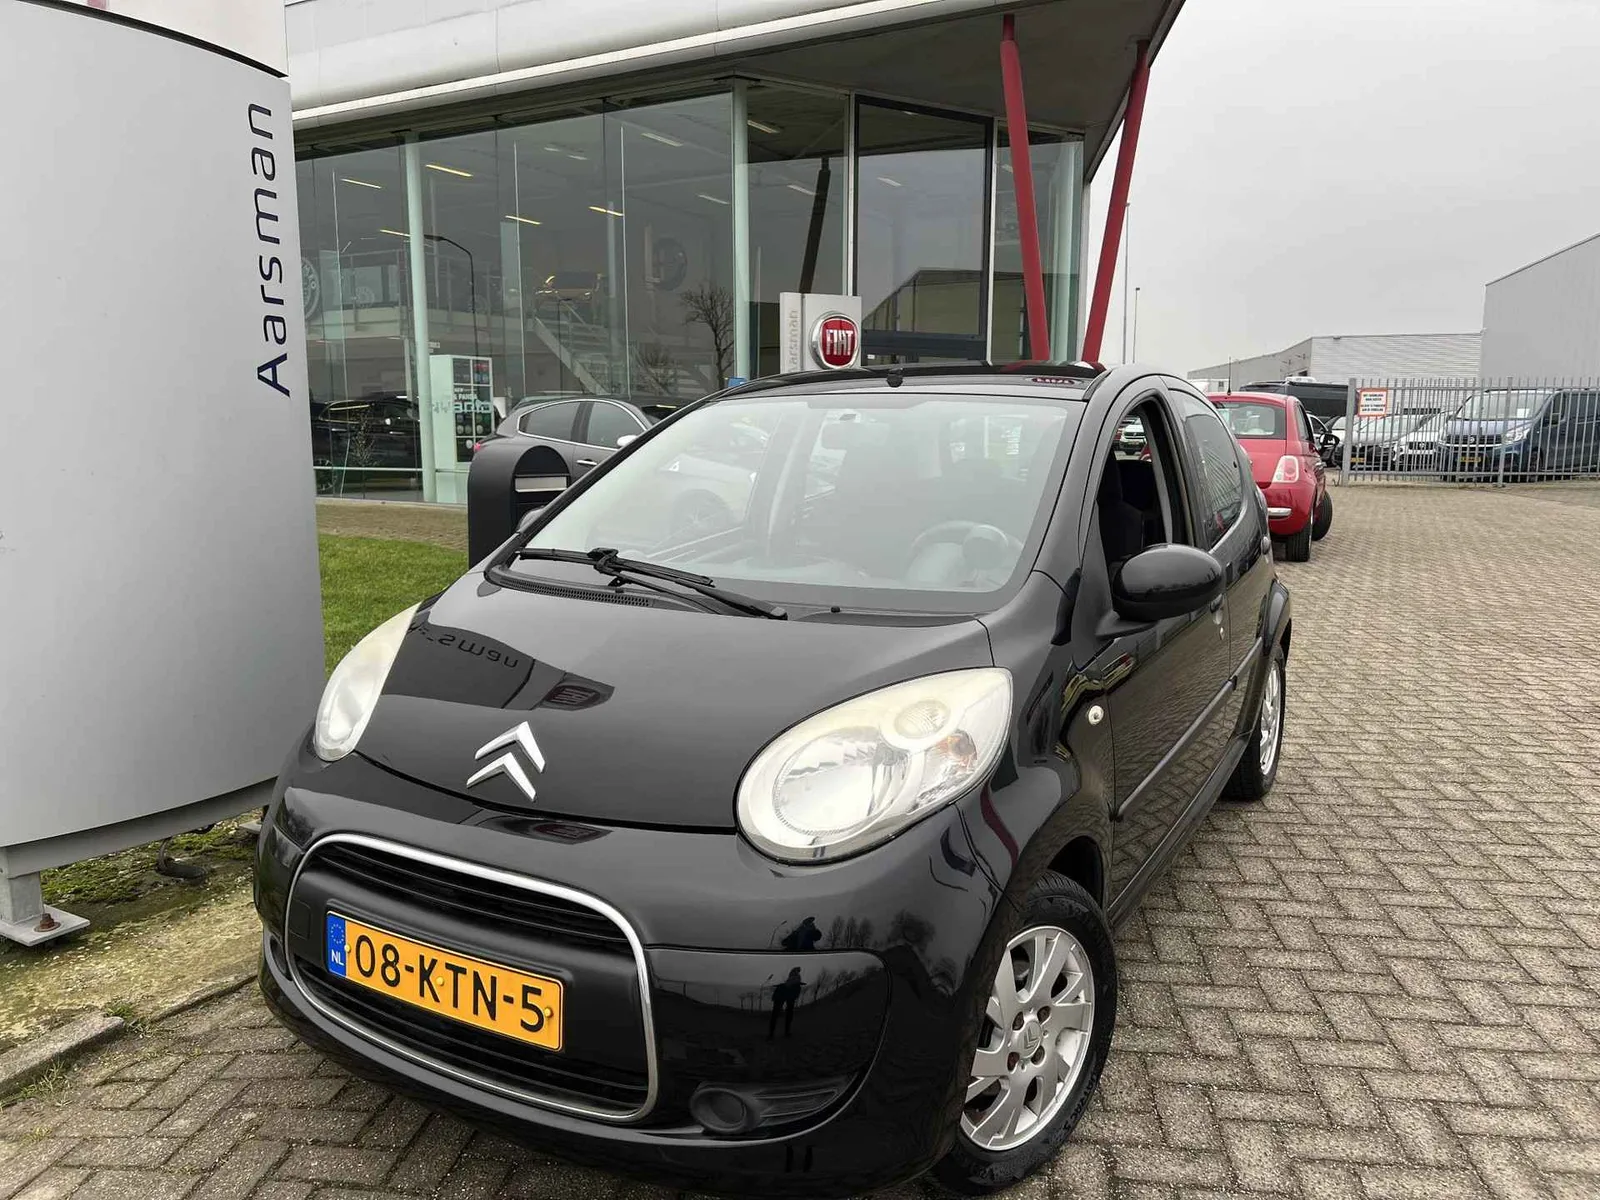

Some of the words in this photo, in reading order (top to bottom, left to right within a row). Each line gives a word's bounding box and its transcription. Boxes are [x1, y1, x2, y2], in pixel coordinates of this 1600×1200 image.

[248, 103, 290, 397] Aarsman
[826, 329, 854, 356] FIAT
[331, 949, 345, 967] NL
[355, 934, 545, 1033] 08-KTN-5
